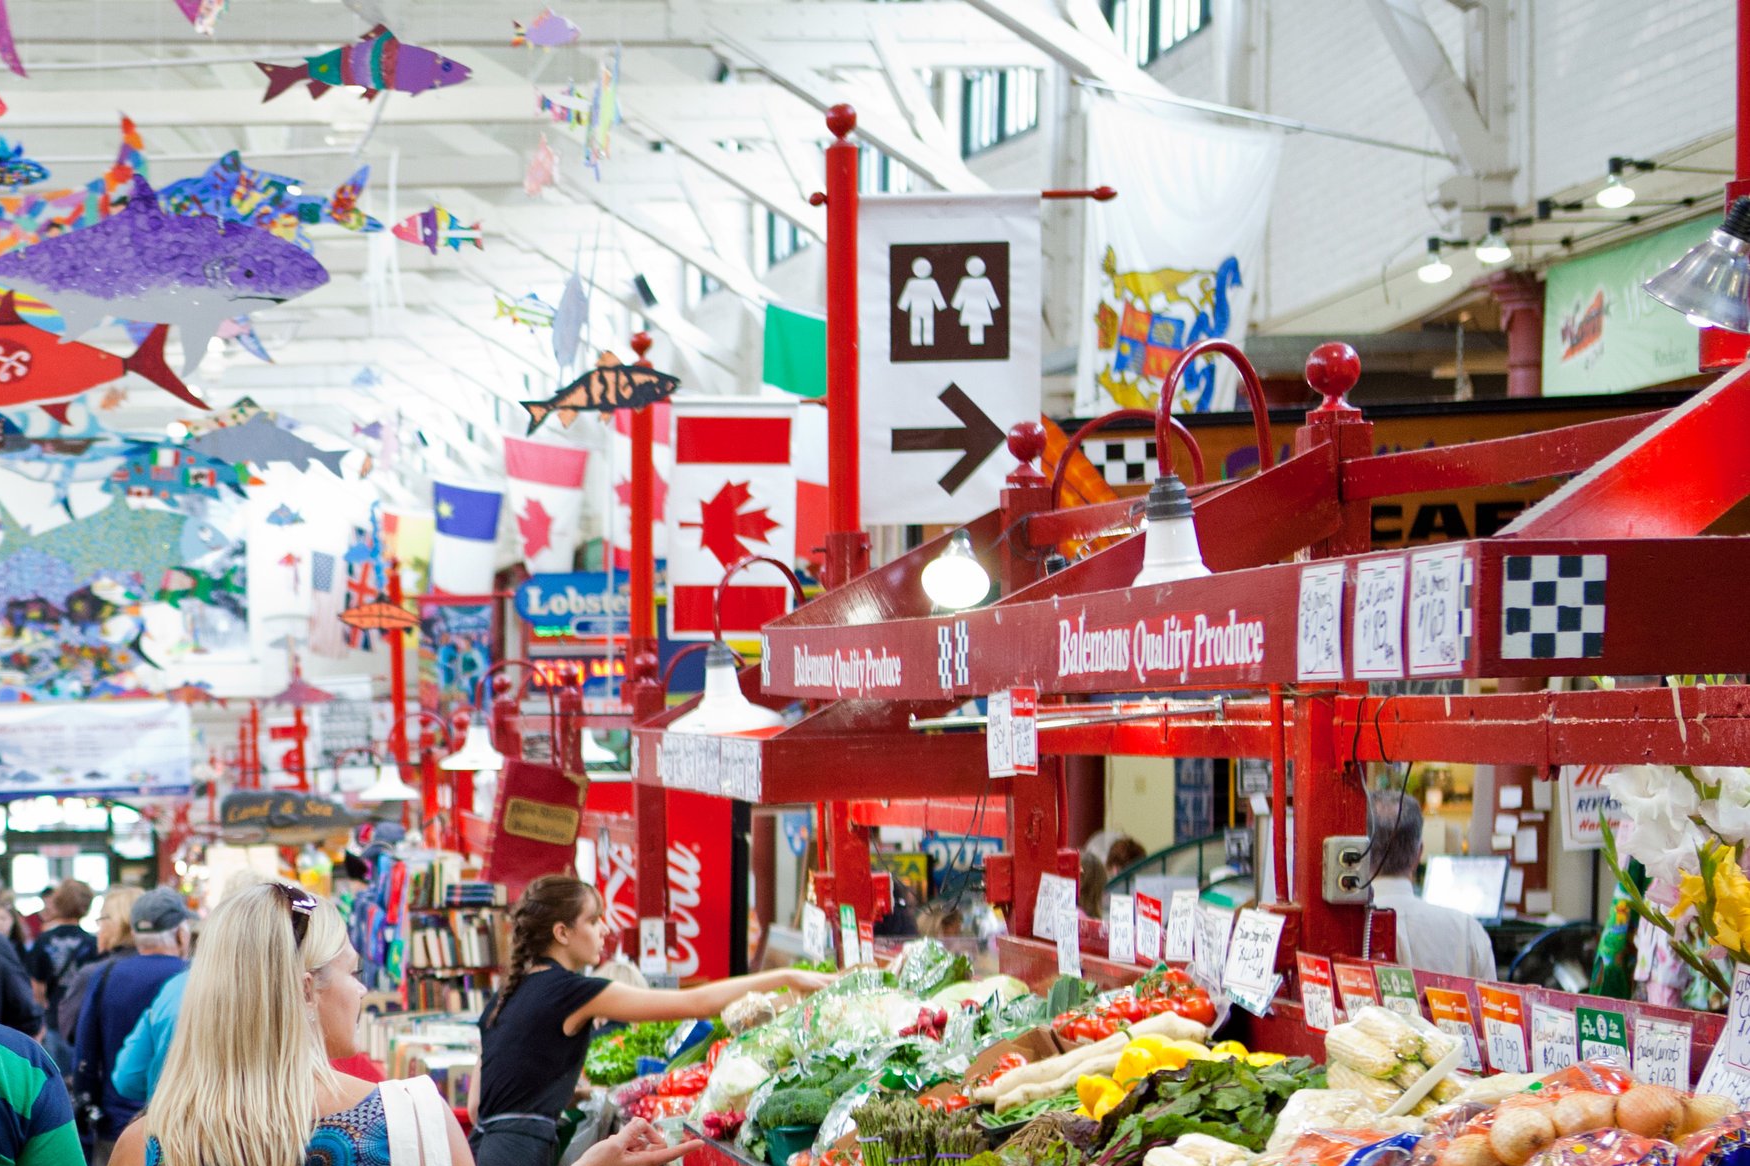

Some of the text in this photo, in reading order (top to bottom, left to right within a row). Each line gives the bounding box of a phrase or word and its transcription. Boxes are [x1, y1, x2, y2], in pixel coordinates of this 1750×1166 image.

[526, 586, 631, 615] Lobste
[794, 643, 902, 698] Balemans Quality Produce
[1058, 615, 1130, 677] Balemans
[1134, 615, 1192, 684] Quality
[1194, 609, 1264, 668] Produce
